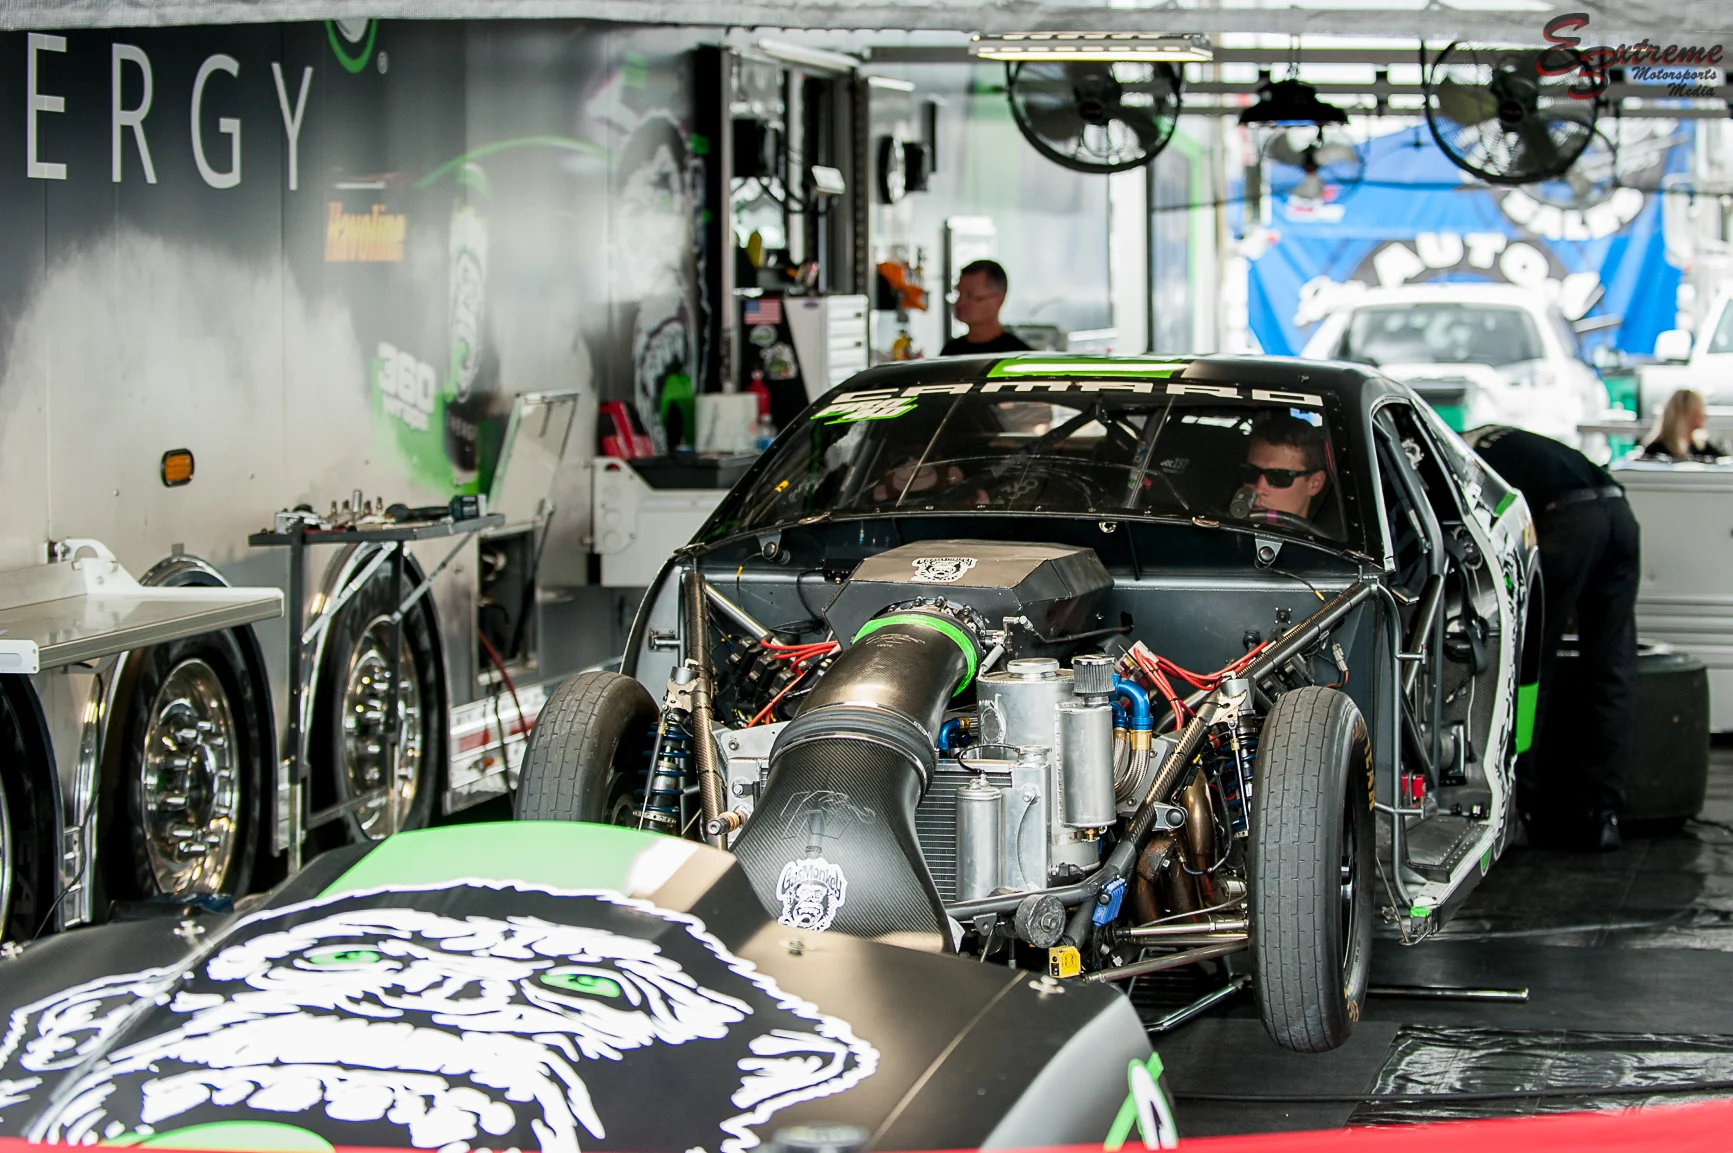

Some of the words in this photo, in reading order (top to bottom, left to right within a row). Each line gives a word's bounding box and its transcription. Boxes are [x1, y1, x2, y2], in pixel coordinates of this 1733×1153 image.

[27, 32, 313, 190] ERGY
[1374, 232, 1549, 289] AUTO
[378, 341, 435, 413] 360
[831, 381, 1323, 407] CAMARO
